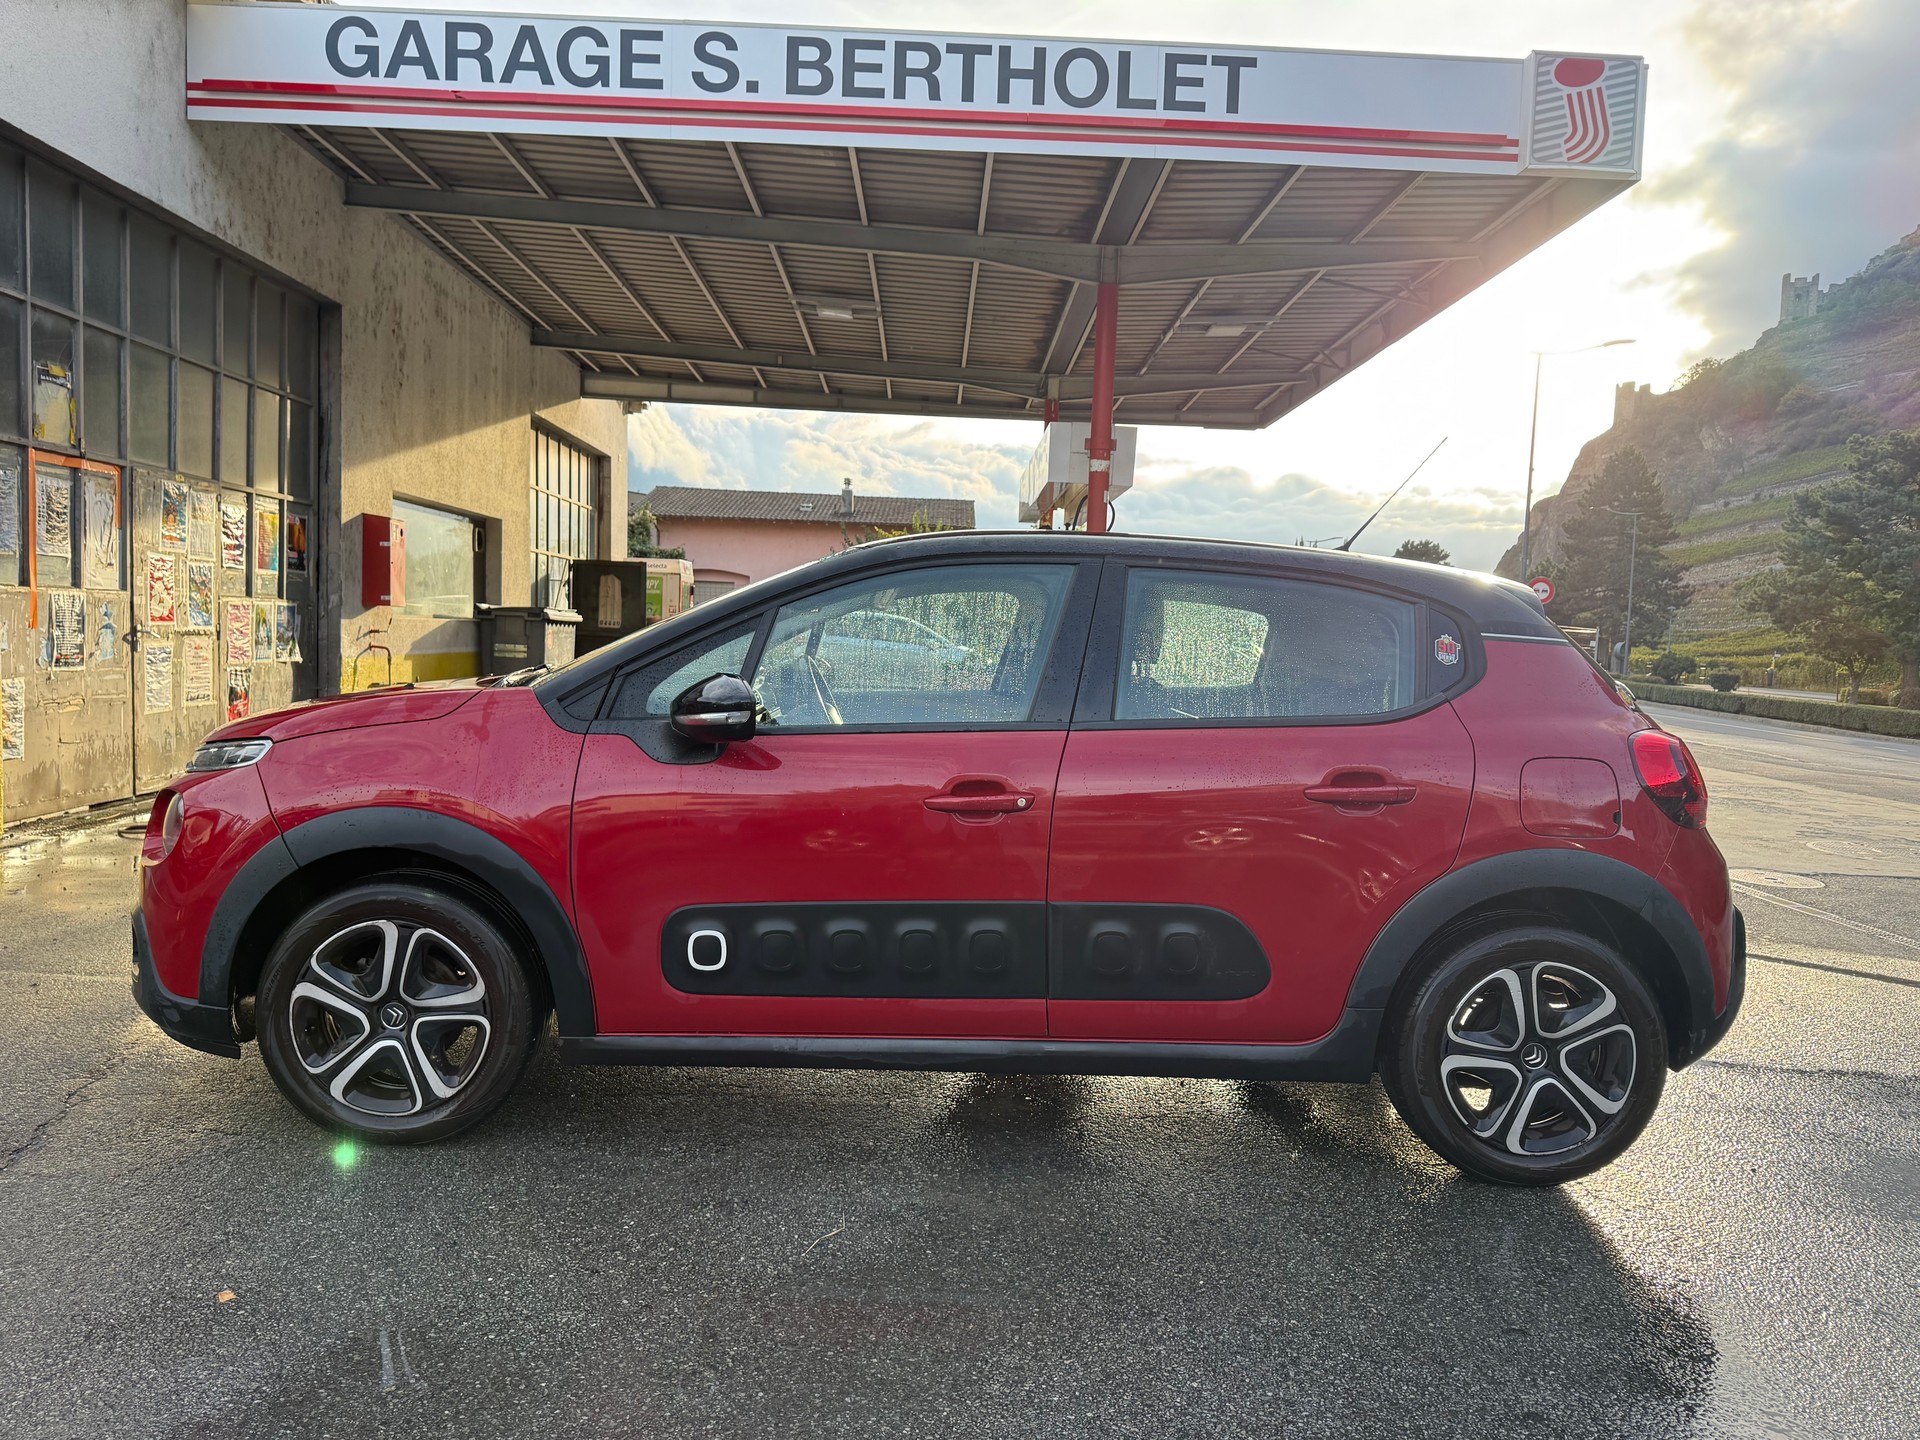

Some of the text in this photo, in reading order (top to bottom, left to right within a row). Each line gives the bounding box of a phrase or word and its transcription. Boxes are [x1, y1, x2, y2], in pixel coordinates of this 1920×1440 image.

[325, 15, 1258, 115] GARAGE S. BERTHOLET
